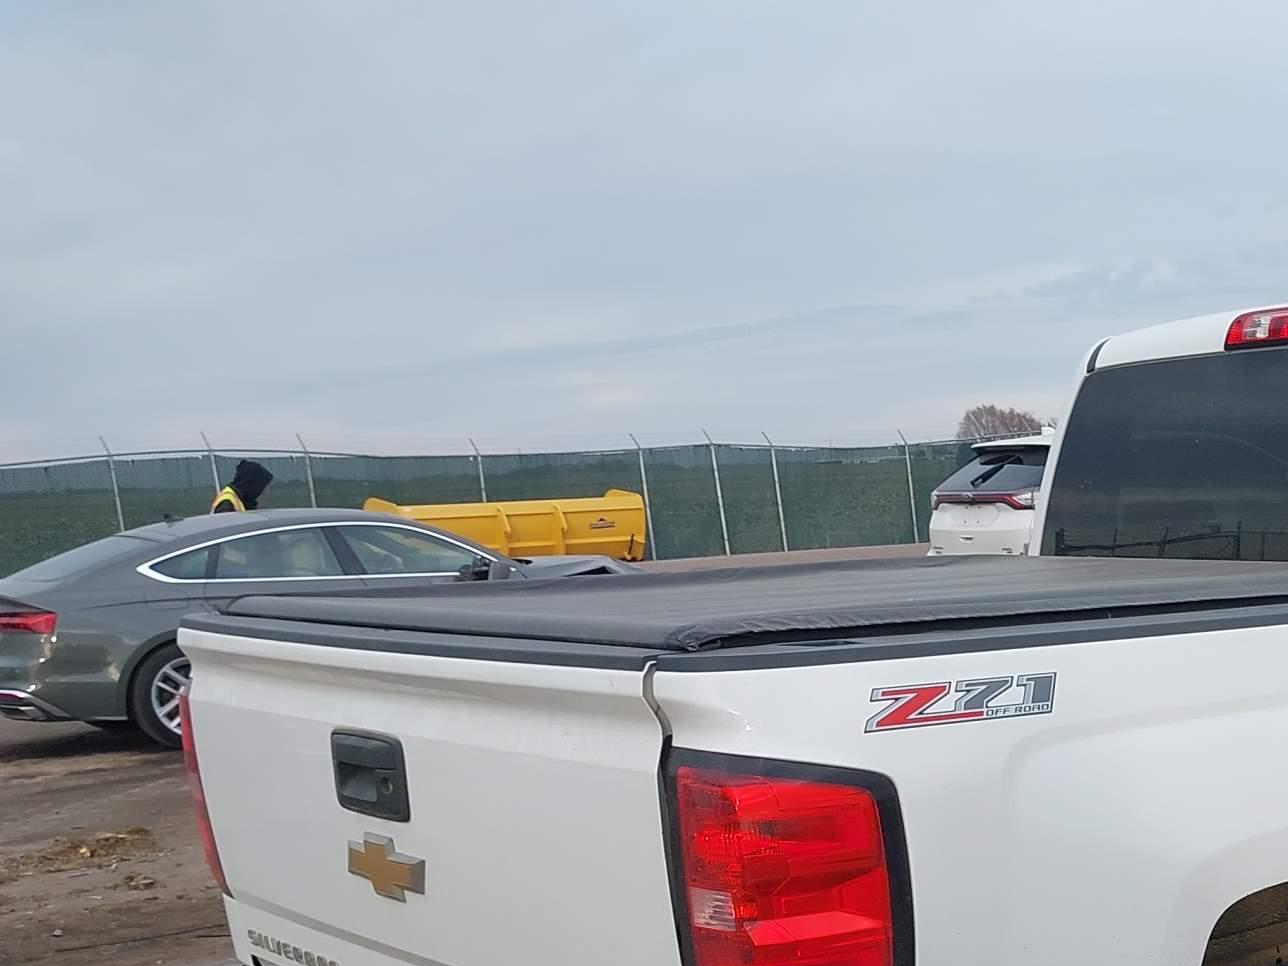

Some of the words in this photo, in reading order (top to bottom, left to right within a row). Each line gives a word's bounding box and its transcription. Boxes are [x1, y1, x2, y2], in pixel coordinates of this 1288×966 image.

[864, 672, 1057, 733] Z71
[985, 707, 1011, 717] OFF
[1014, 703, 1050, 713] ROAD
